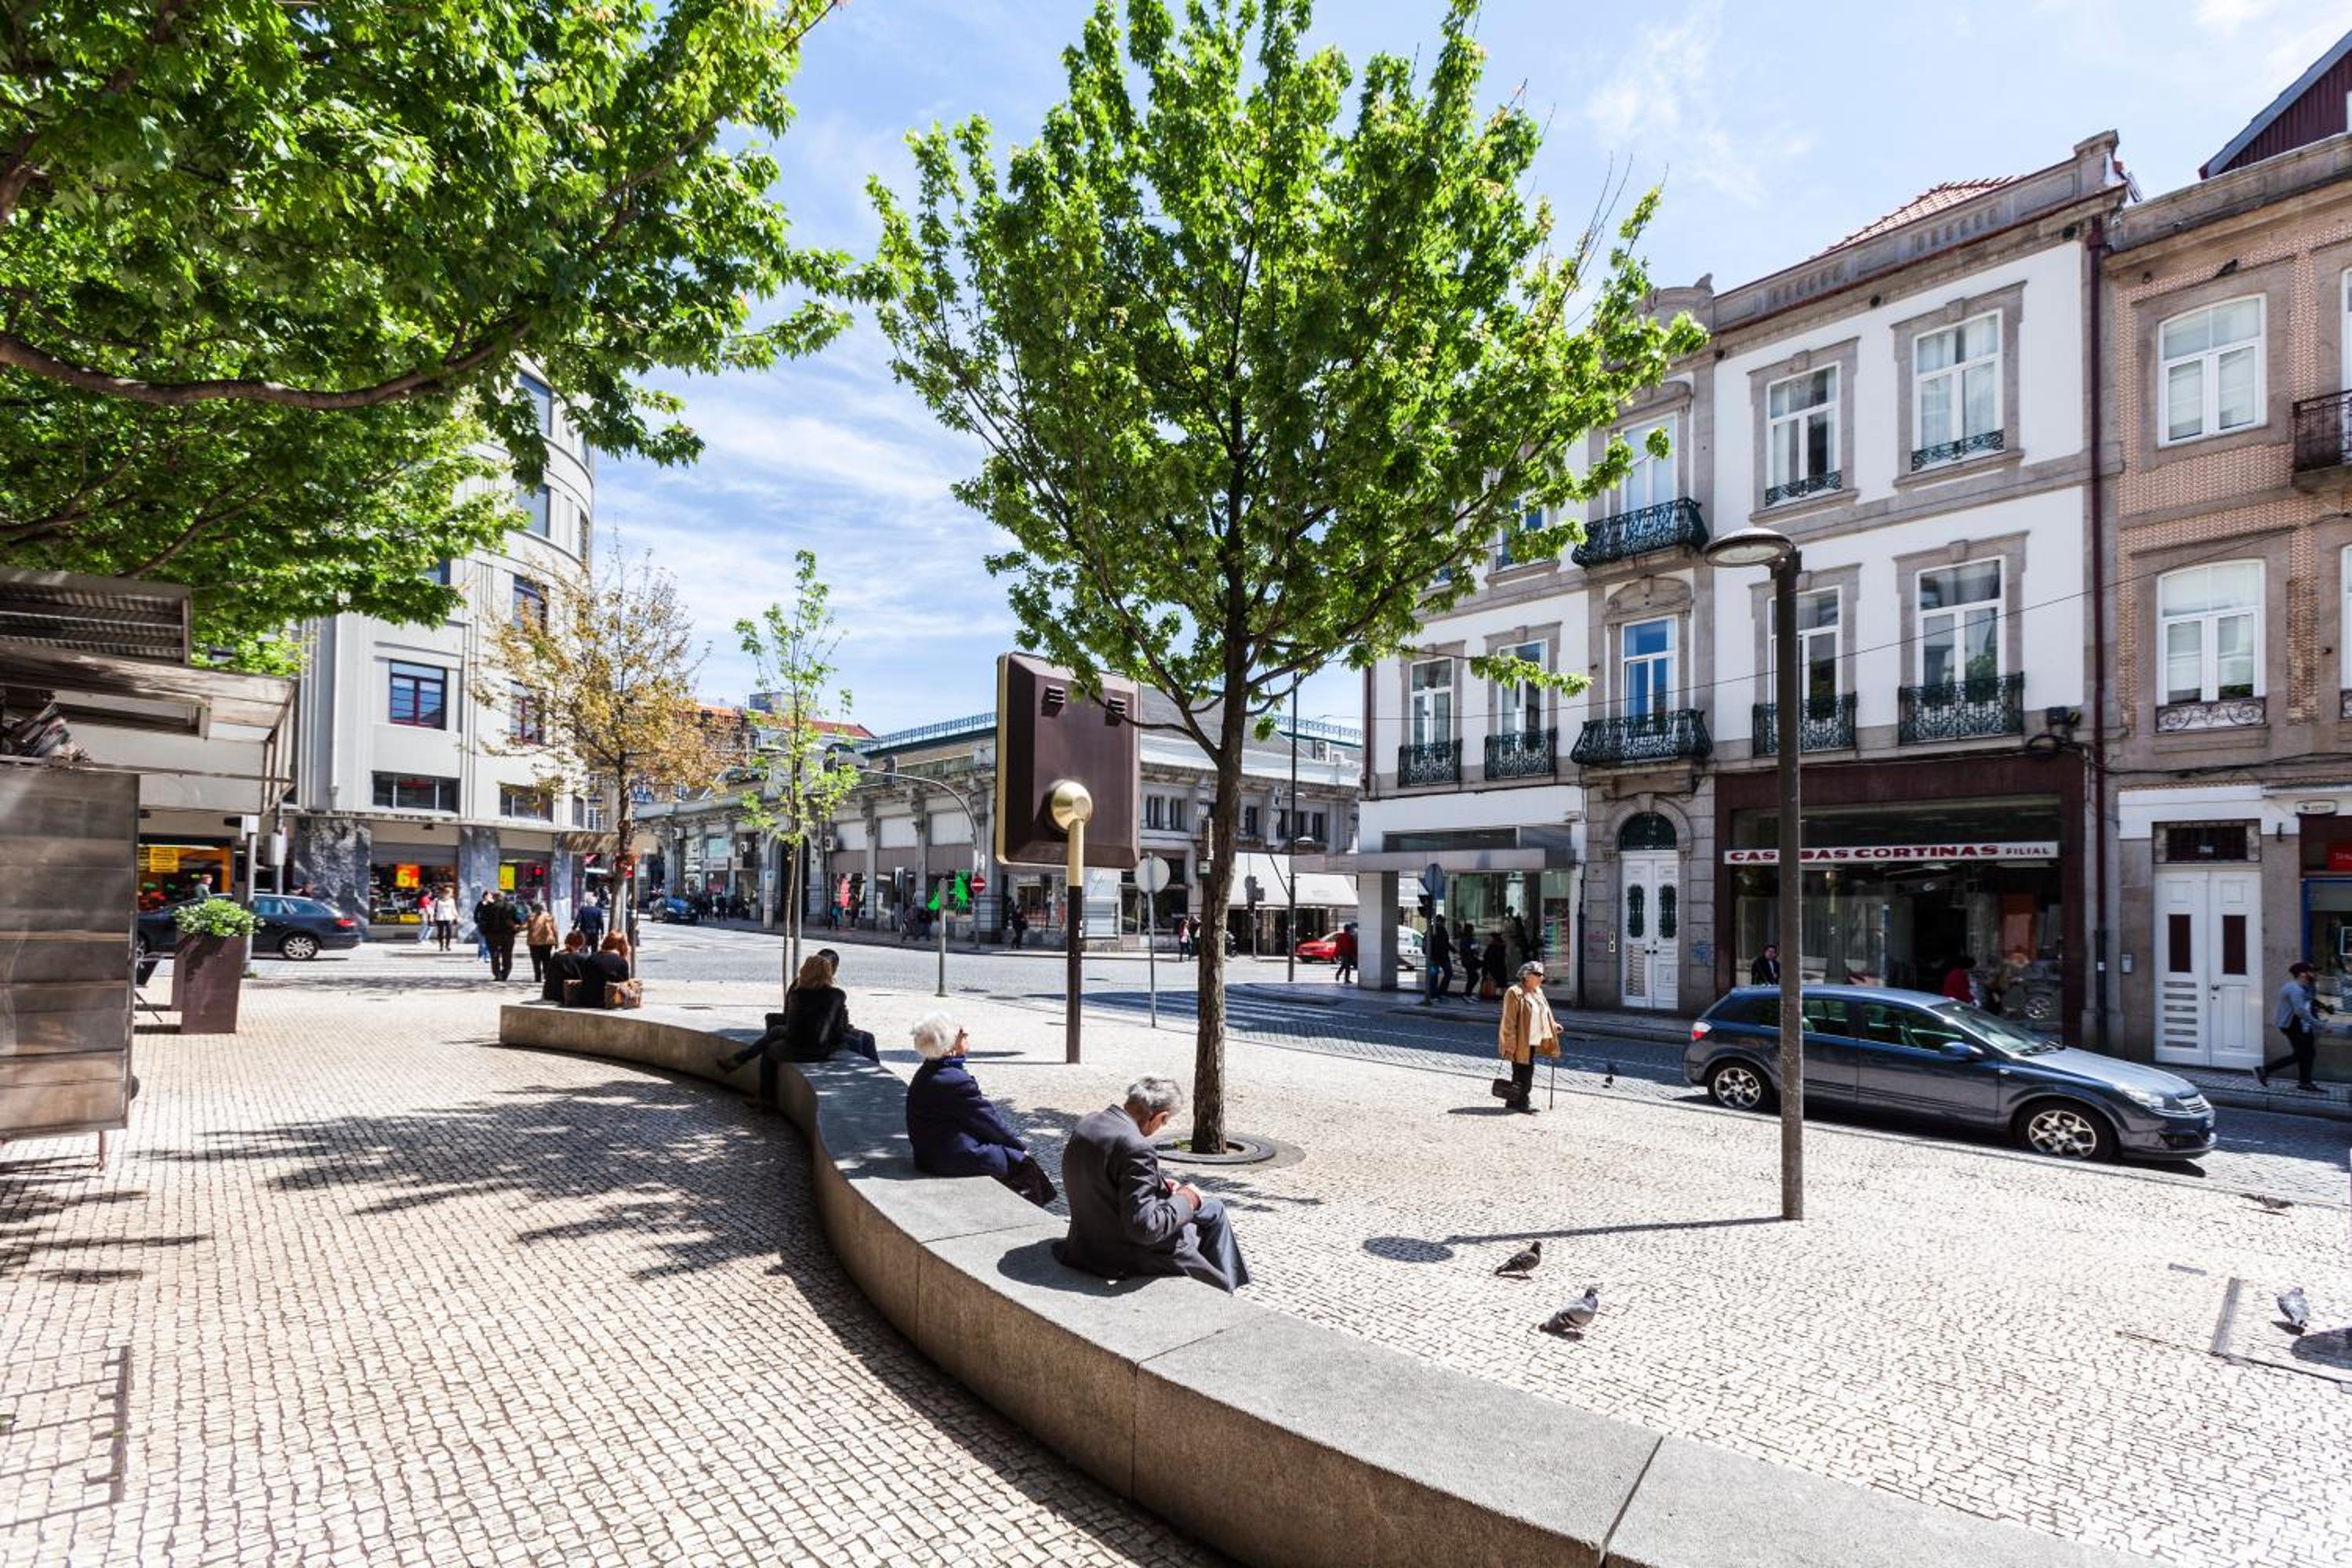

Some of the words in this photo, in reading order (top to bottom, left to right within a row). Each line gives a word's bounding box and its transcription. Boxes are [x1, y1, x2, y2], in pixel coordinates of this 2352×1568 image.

[1730, 851, 1777, 861] CAS
[1800, 849, 1849, 860] DAS
[1854, 845, 1998, 858] CORTINAS
